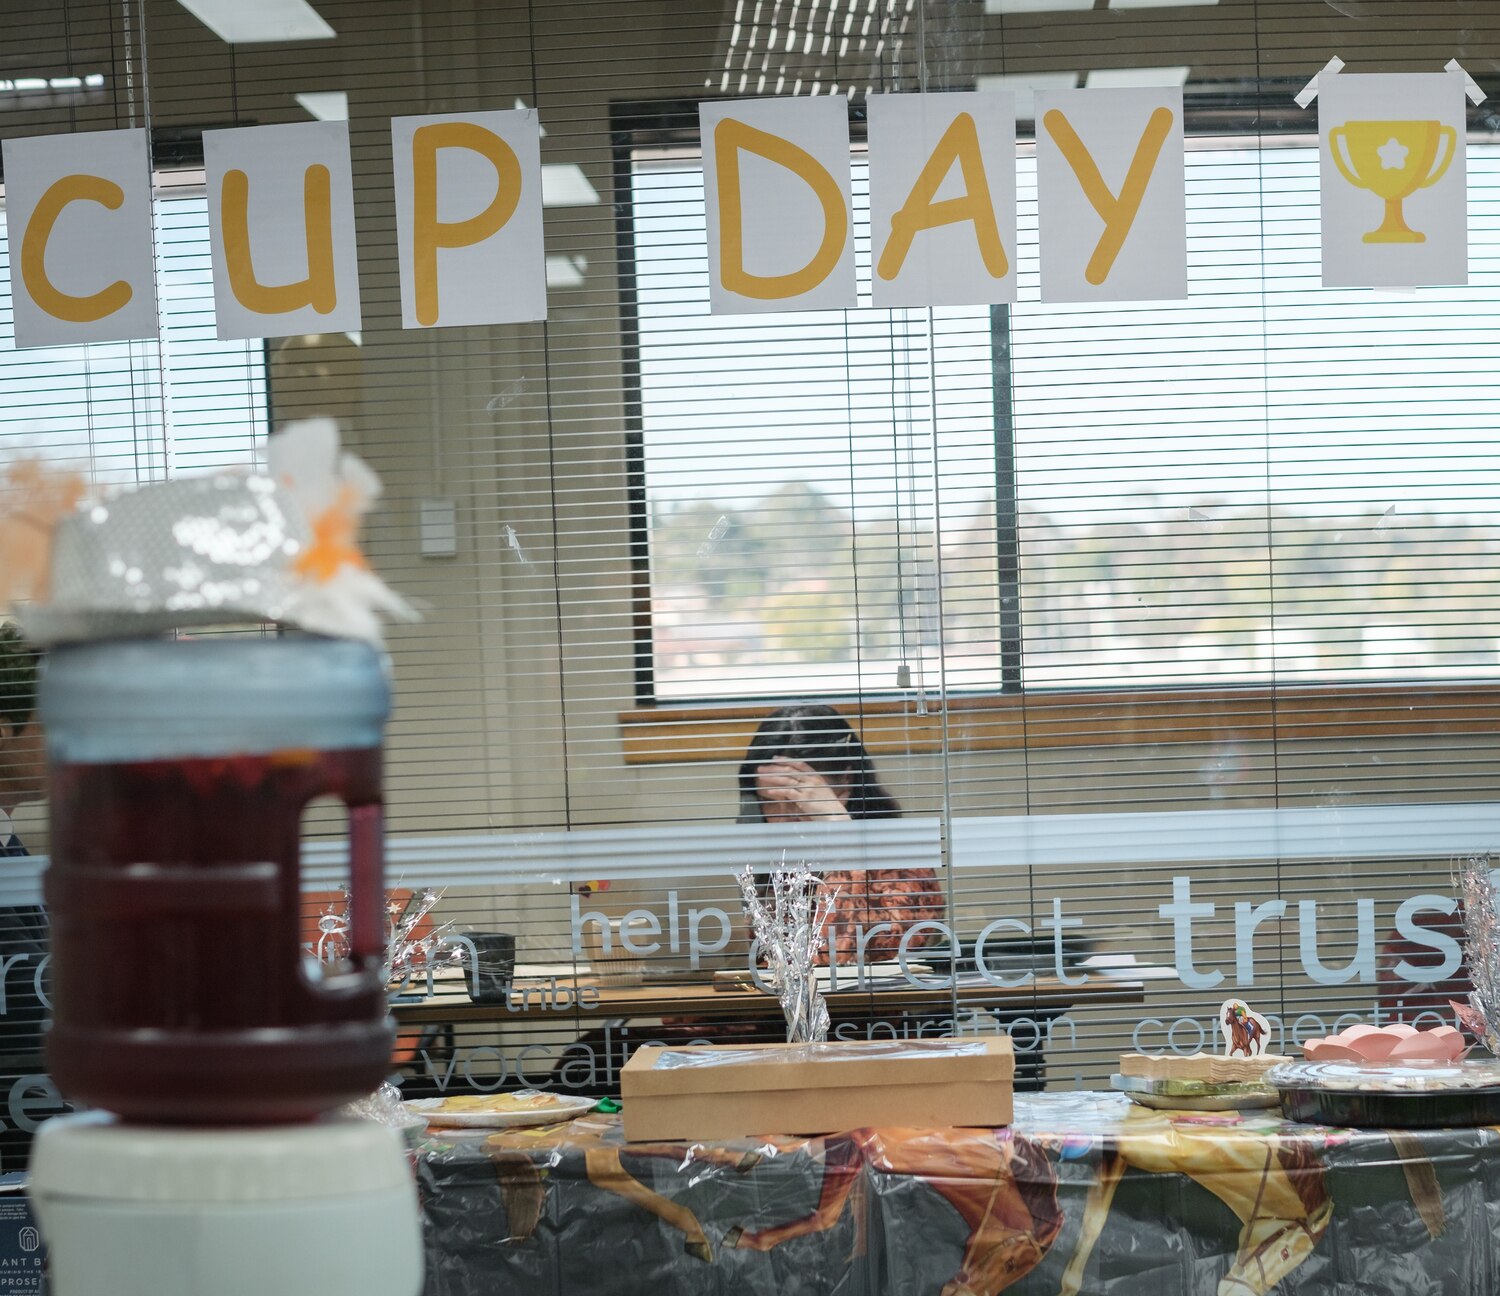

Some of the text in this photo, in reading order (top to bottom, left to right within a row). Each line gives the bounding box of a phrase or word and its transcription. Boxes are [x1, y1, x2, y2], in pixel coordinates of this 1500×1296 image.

[714, 106, 1174, 301] DAY
[570, 890, 732, 971] help
[505, 977, 601, 1012] tribe
[1, 1277, 41, 1286] PROSE
